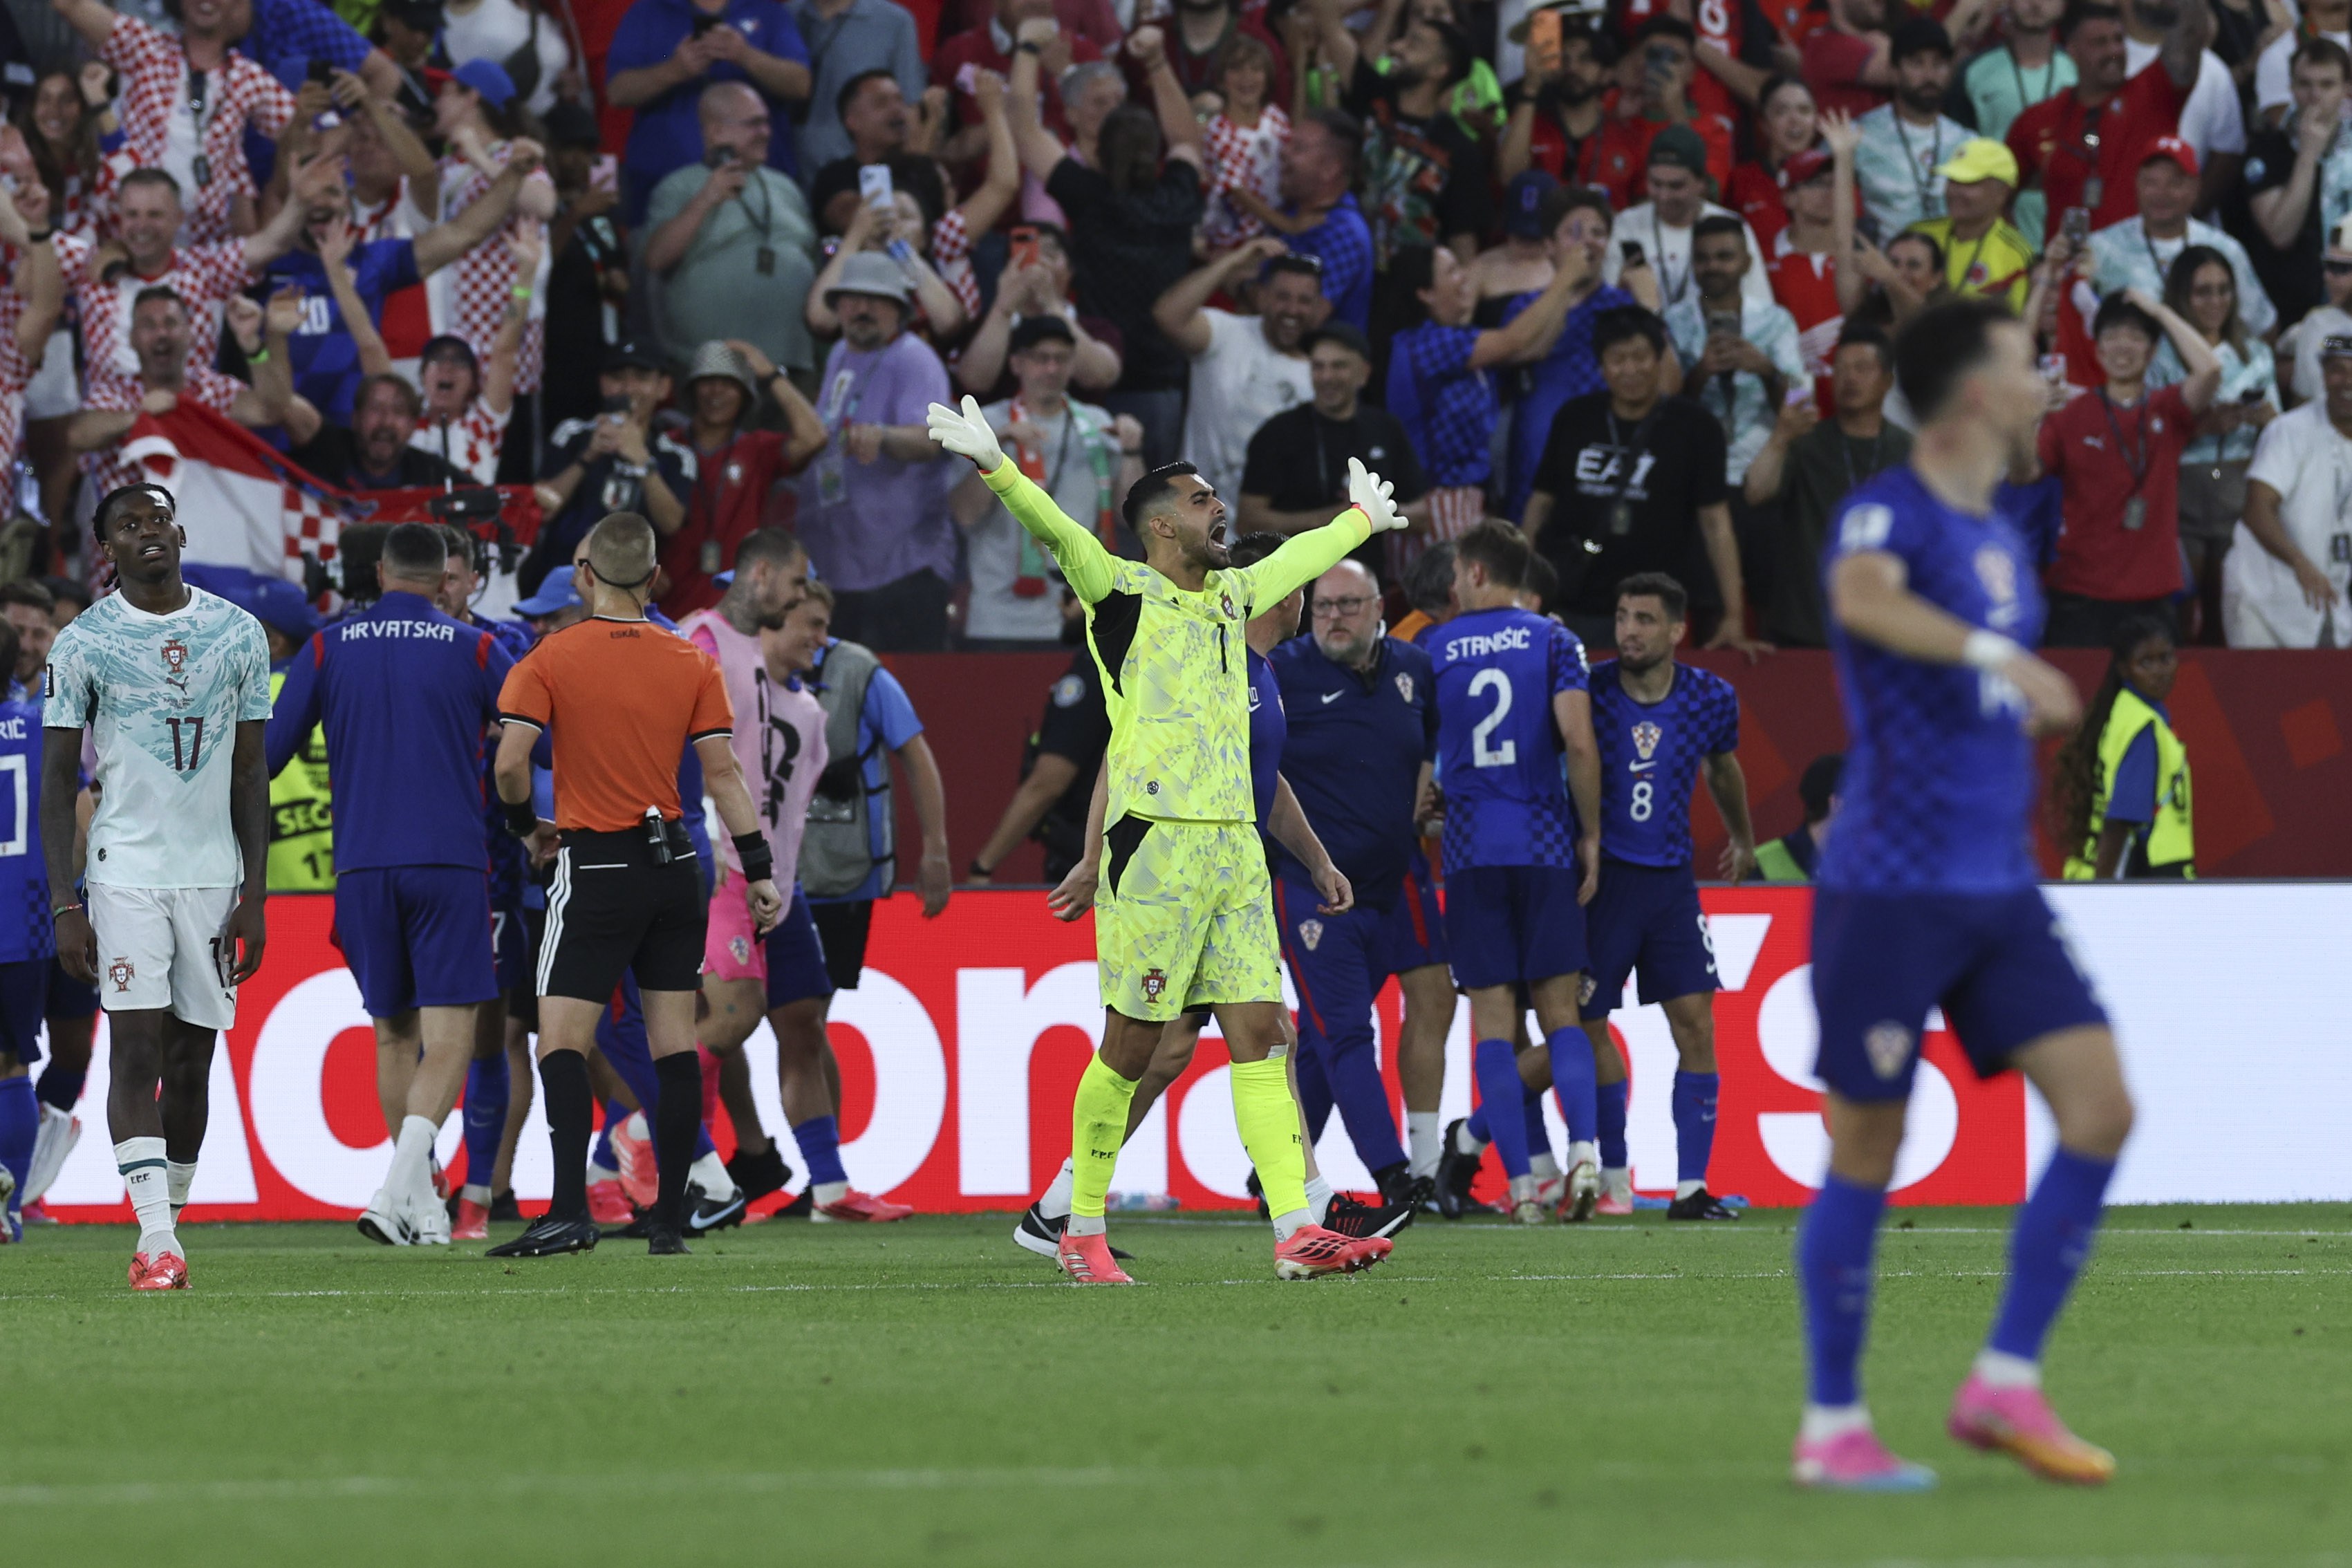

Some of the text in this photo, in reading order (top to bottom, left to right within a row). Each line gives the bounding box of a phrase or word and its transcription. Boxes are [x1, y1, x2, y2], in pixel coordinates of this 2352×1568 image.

[342, 619, 455, 643] HRVATSKA
[1217, 622, 1228, 674] 1
[165, 716, 205, 771] 17
[1467, 667, 1517, 768] 2
[1630, 781, 1653, 823] 8
